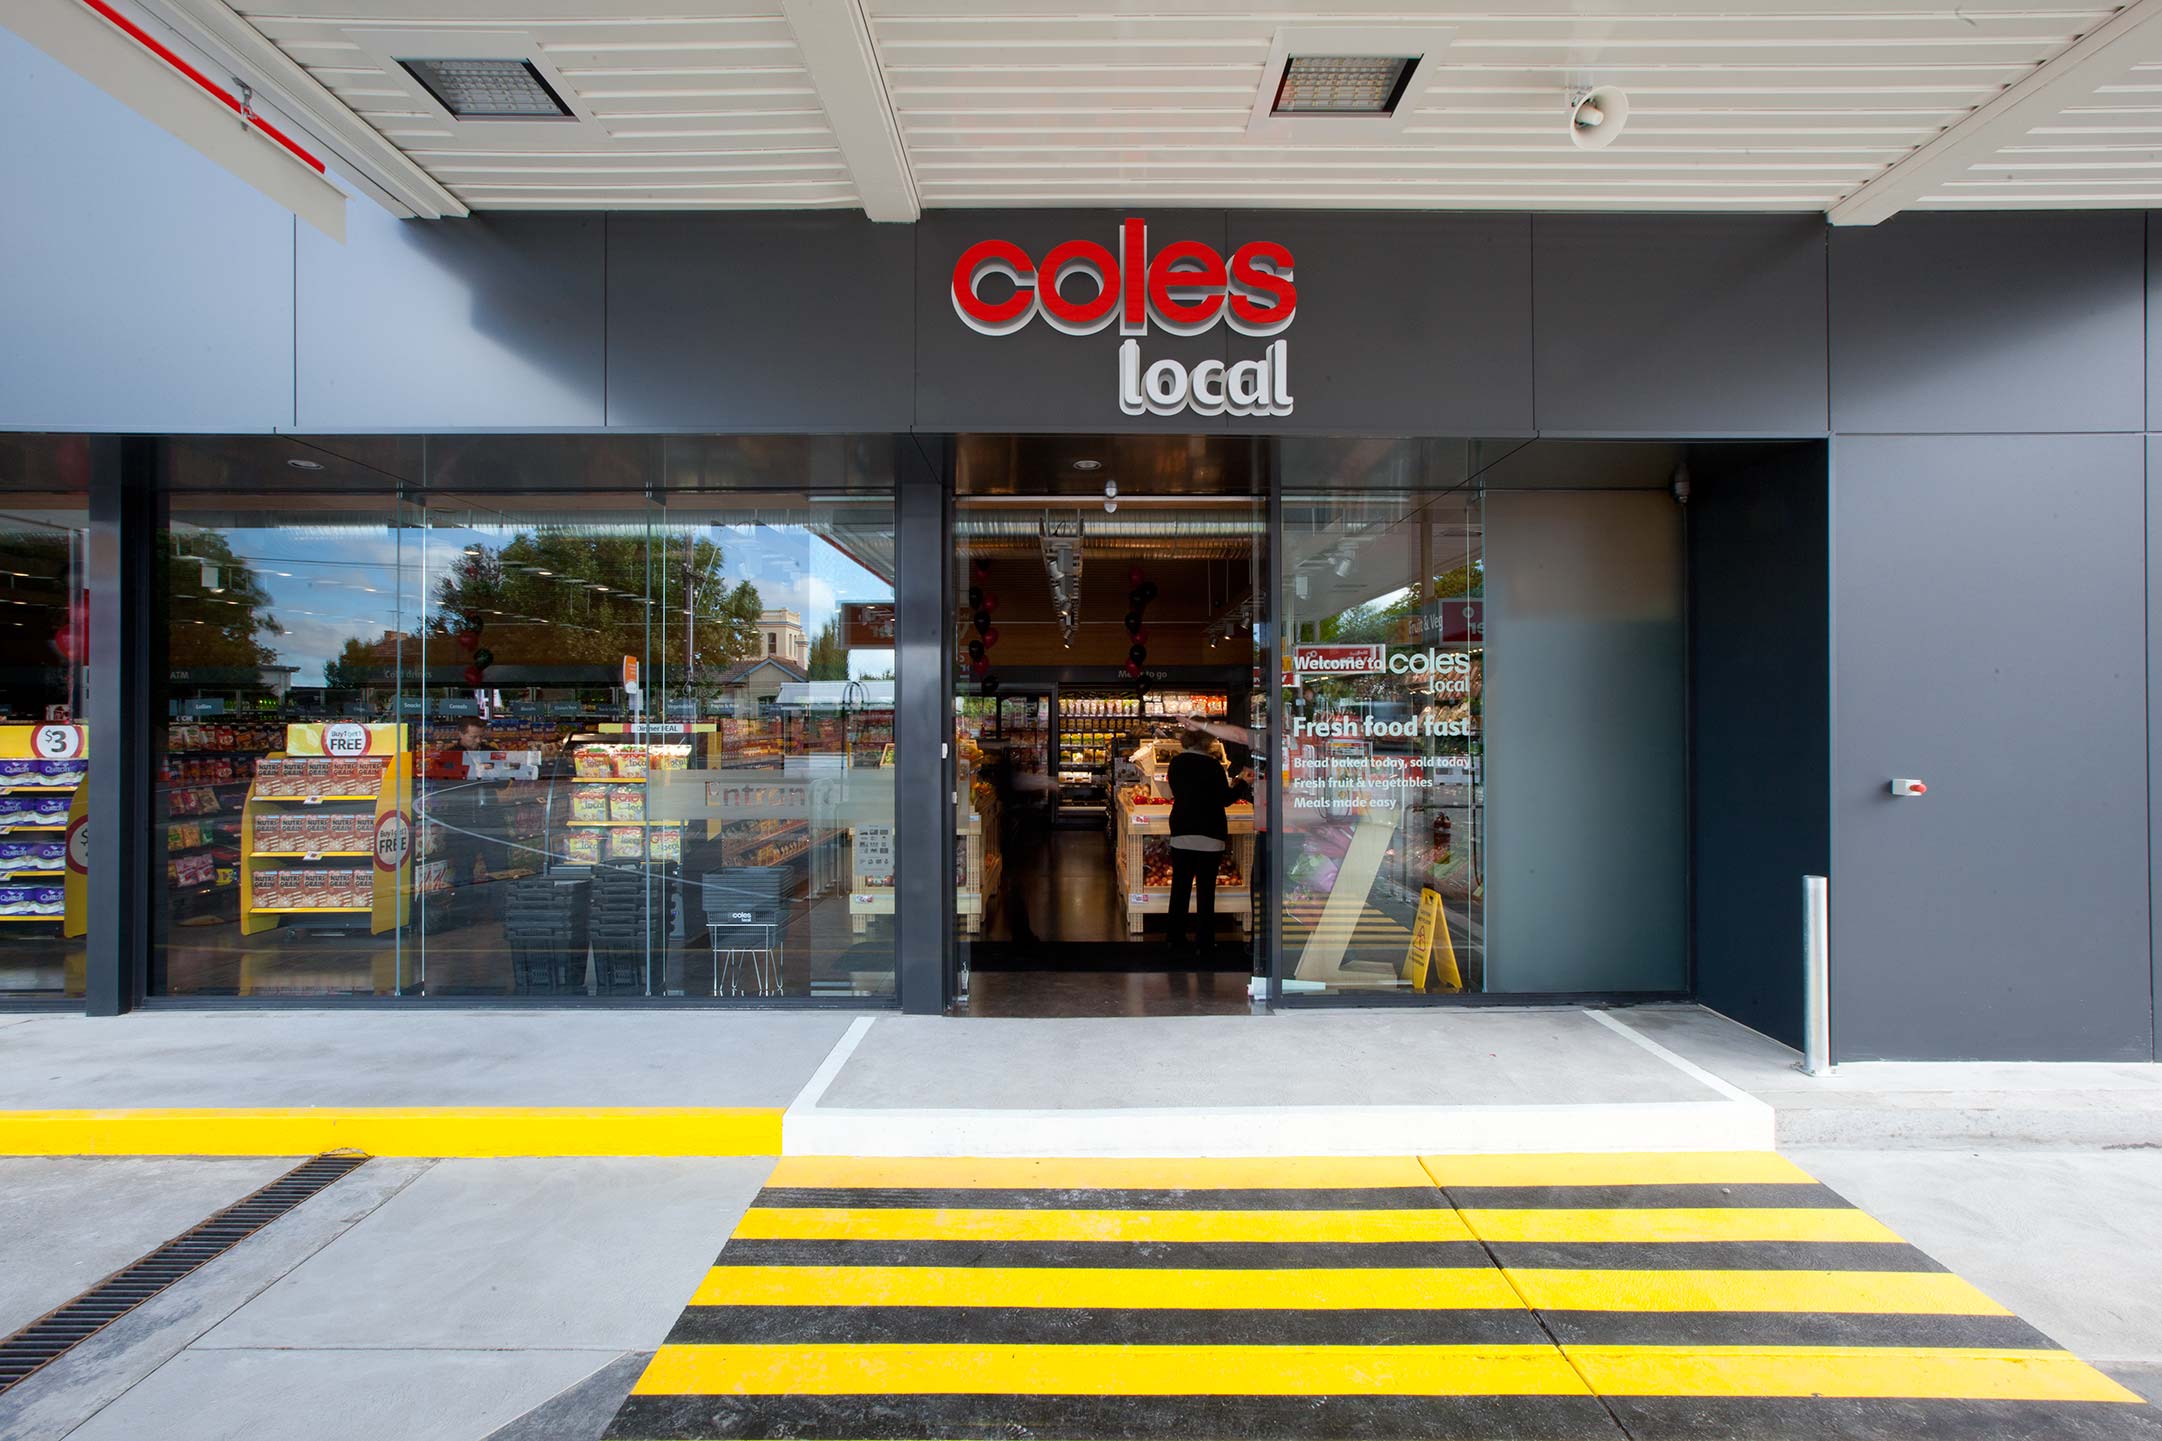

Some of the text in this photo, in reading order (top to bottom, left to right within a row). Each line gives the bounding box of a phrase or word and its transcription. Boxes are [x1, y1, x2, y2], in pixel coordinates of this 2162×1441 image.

[952, 218, 1297, 335] coles
[1119, 339, 1294, 416] local
[1409, 618, 1423, 635] Fruit
[1430, 613, 1443, 632] Veg
[1294, 647, 1470, 674] Welcome to coles
[170, 671, 189, 680] ATM
[1156, 672, 1168, 680] go
[1430, 675, 1469, 692] local
[1294, 714, 1357, 737] Fresh
[1364, 715, 1418, 737] food
[330, 738, 362, 750] FREE
[1294, 756, 1471, 771] Bread baked today, sold today
[1294, 777, 1433, 791] Fresh fruit & vegetables
[1294, 797, 1397, 810] Meals made easy
